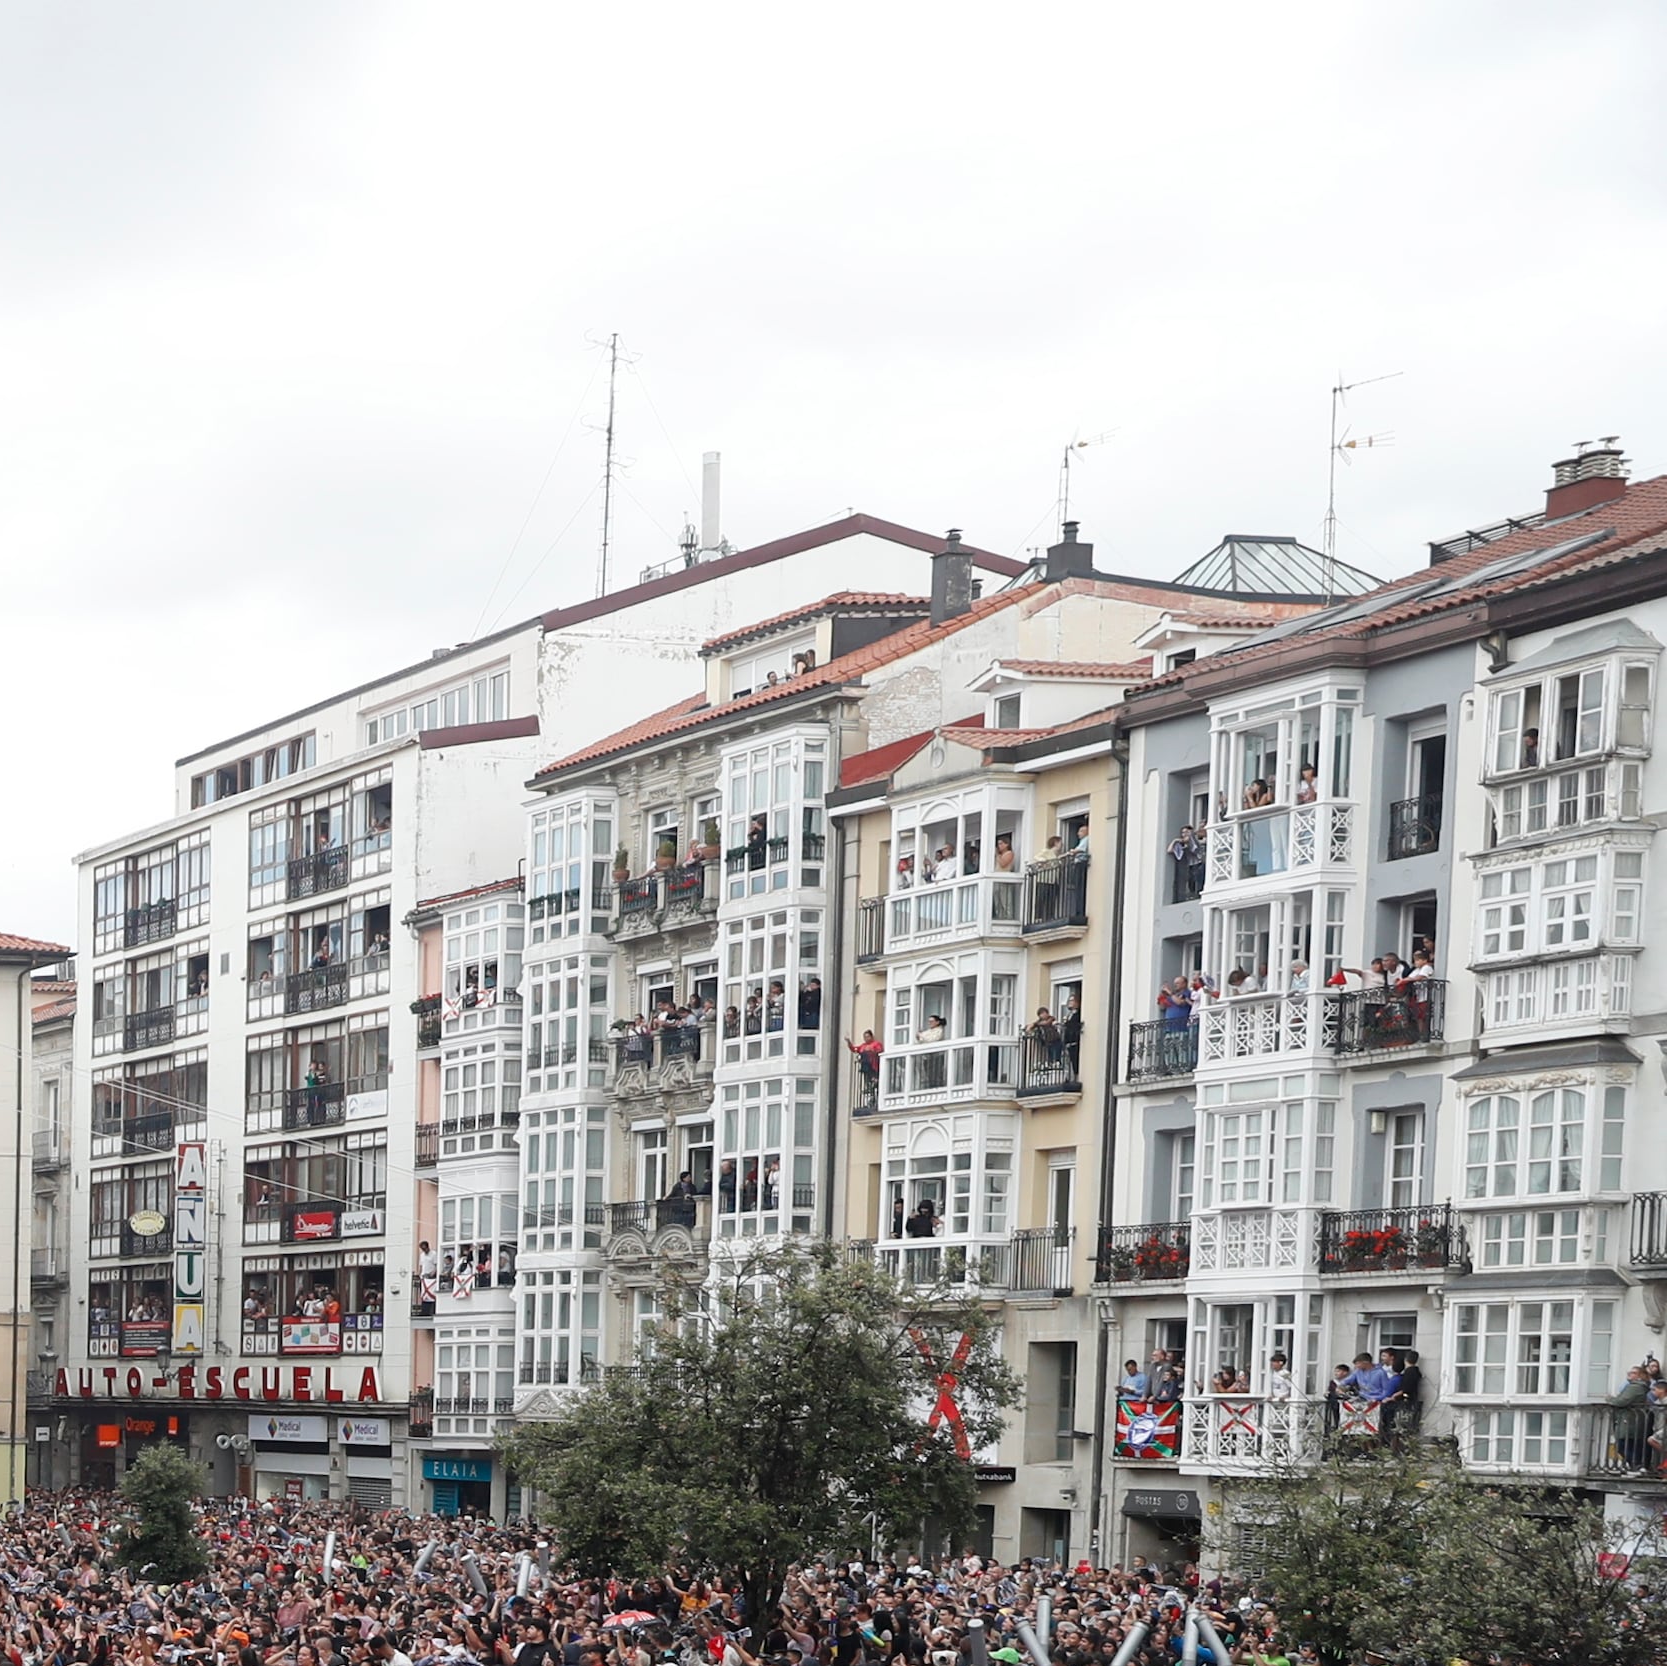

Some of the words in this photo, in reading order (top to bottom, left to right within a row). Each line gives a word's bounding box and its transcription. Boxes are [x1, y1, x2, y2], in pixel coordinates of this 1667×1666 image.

[125, 1416, 156, 1436] Orange
[278, 1420, 301, 1432] Medical
[354, 1423, 379, 1435] Medical
[433, 1461, 478, 1478] ELAIA
